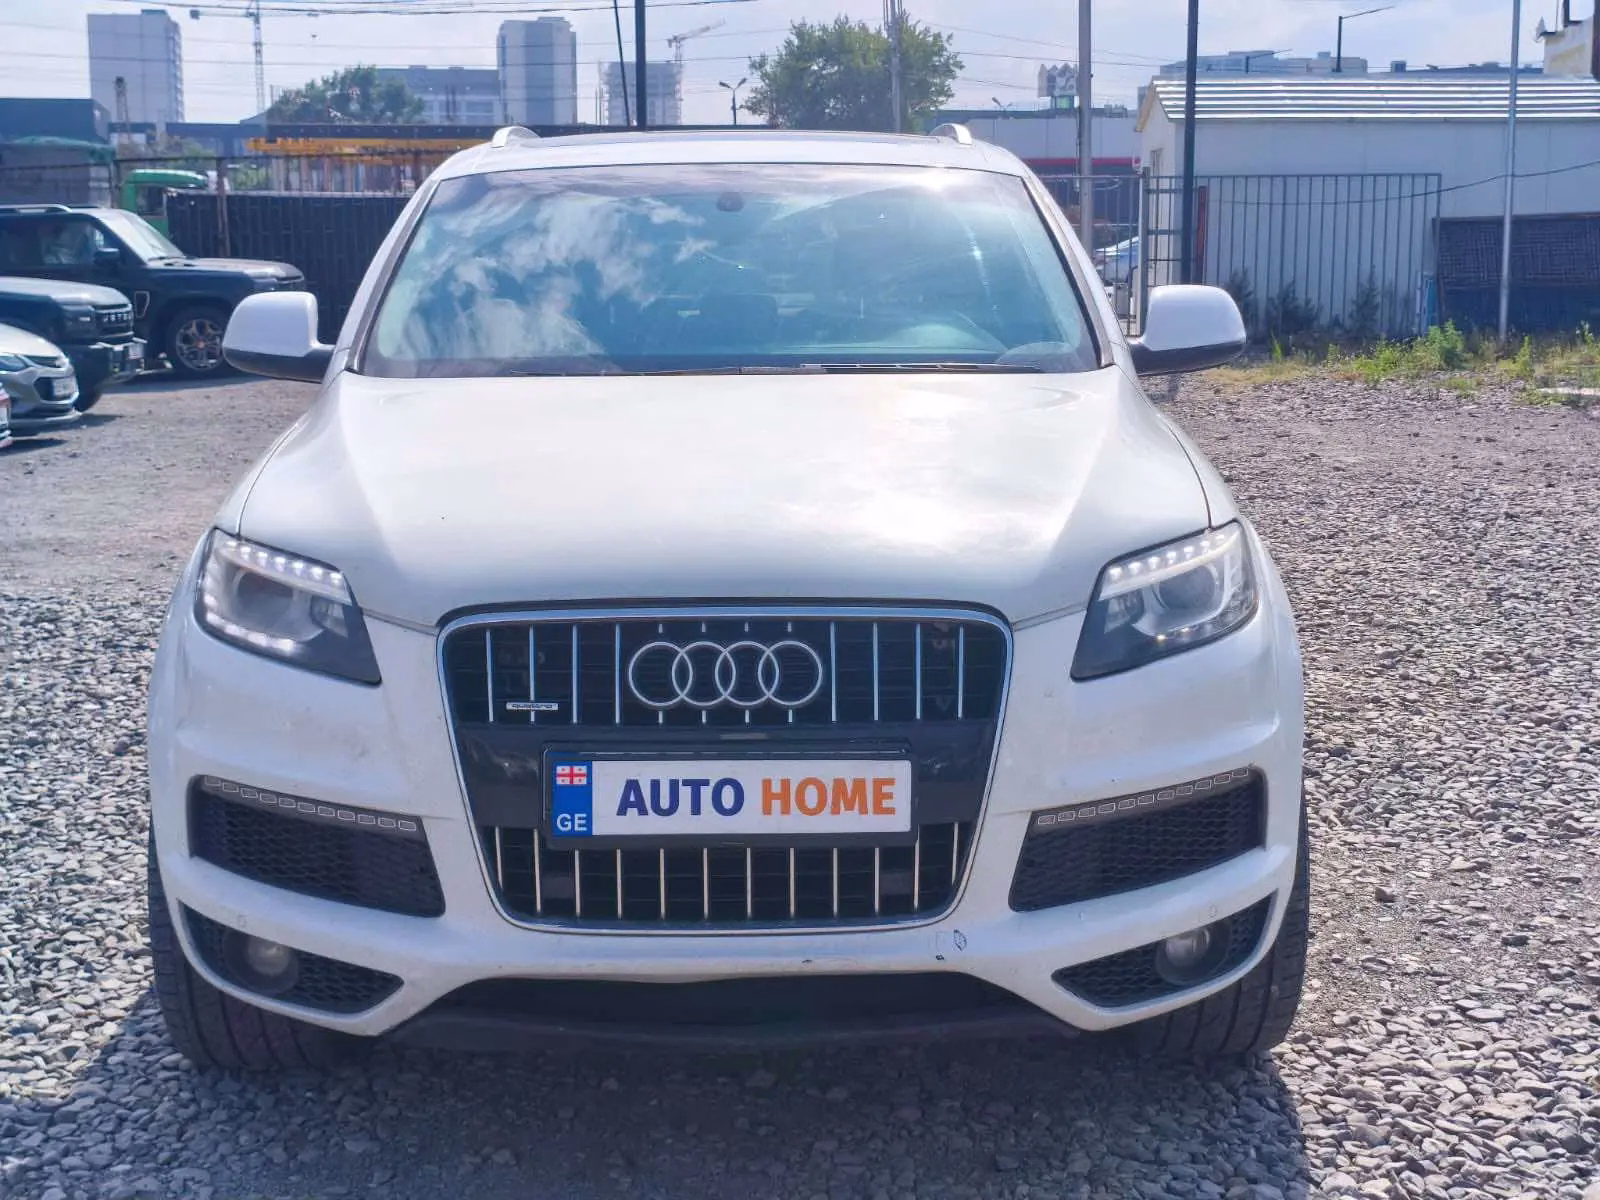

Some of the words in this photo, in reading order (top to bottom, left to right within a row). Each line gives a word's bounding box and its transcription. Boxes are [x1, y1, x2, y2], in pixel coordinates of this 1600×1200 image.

[615, 777, 745, 817] AUTO
[761, 777, 896, 816] HOME
[556, 813, 588, 832] GE
